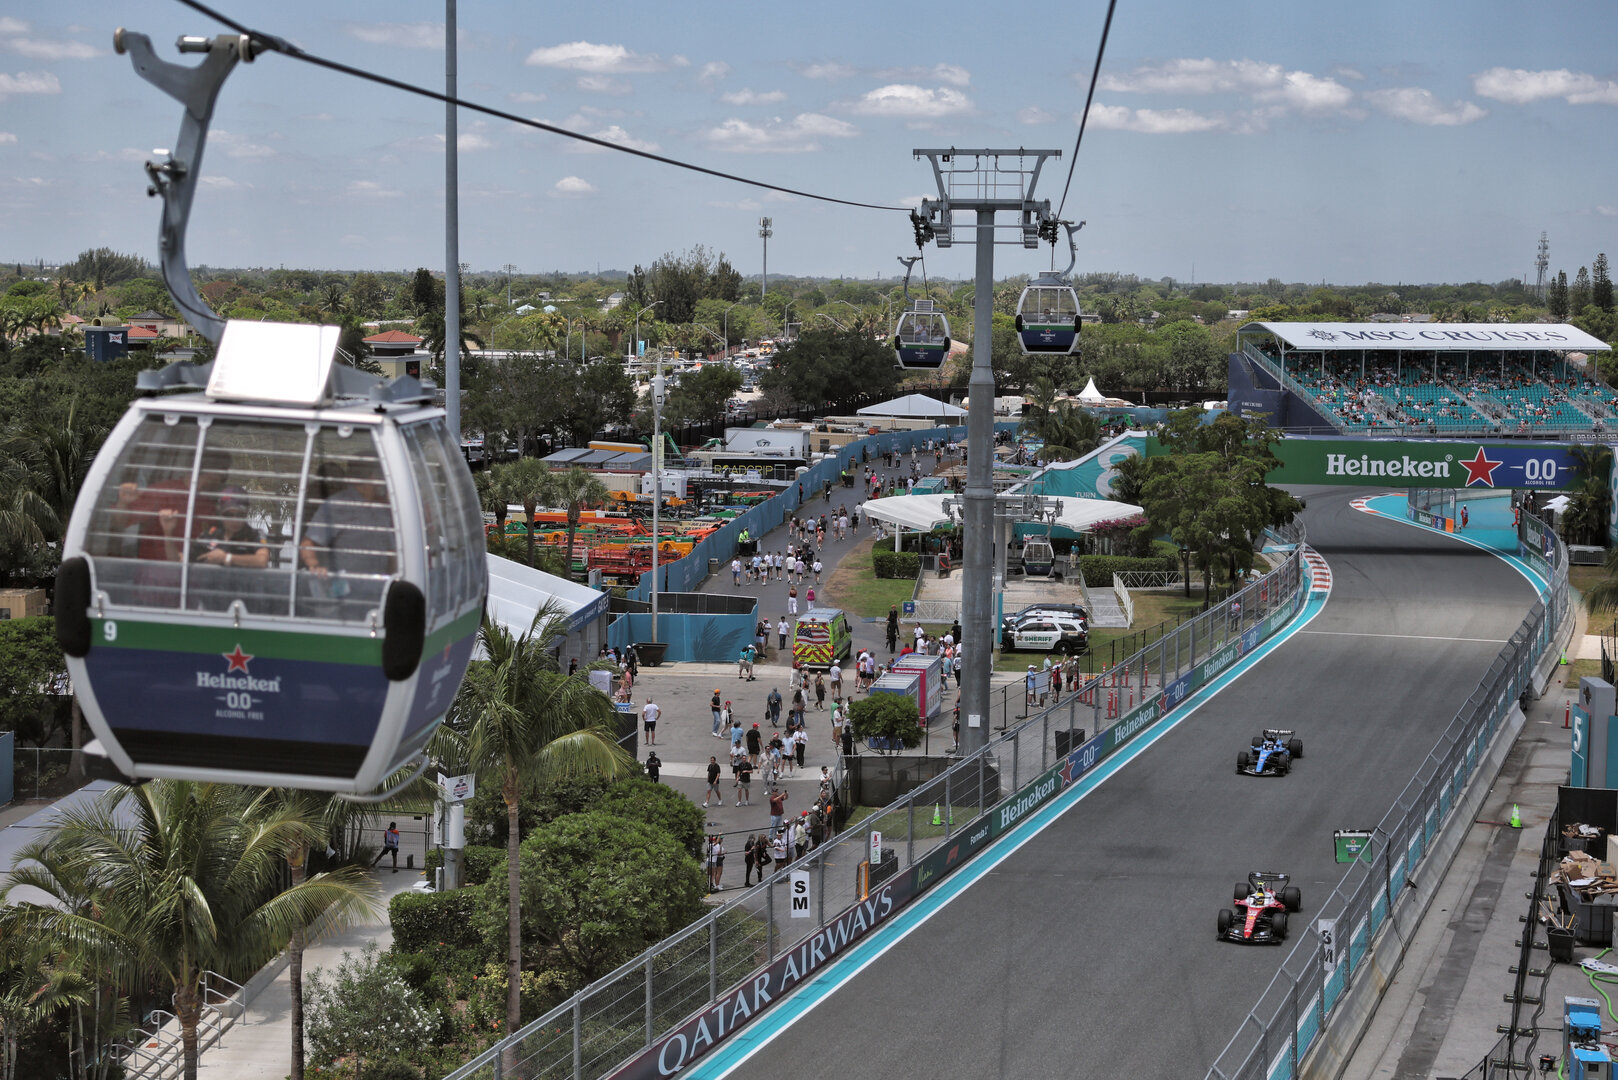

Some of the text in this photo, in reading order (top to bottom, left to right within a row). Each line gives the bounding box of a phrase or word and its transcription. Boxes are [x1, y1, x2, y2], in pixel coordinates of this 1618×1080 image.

[1339, 331, 1568, 341] MSC CRUISES
[714, 465, 774, 476] RADGRIP
[1326, 454, 1450, 478] Heineken
[1525, 459, 1556, 480] 0.0
[1075, 491, 1097, 499] TURN
[104, 621, 117, 641] 9
[1203, 649, 1234, 680] Heineken
[197, 672, 280, 692] Heineken
[215, 709, 264, 720] ALCOHOL FREE
[1114, 705, 1155, 745] Heineken
[1573, 715, 1582, 752] 5
[1084, 745, 1095, 767] 0.0
[1000, 776, 1056, 829] Heineken
[658, 885, 893, 1076] QATAR AIRWAYS
